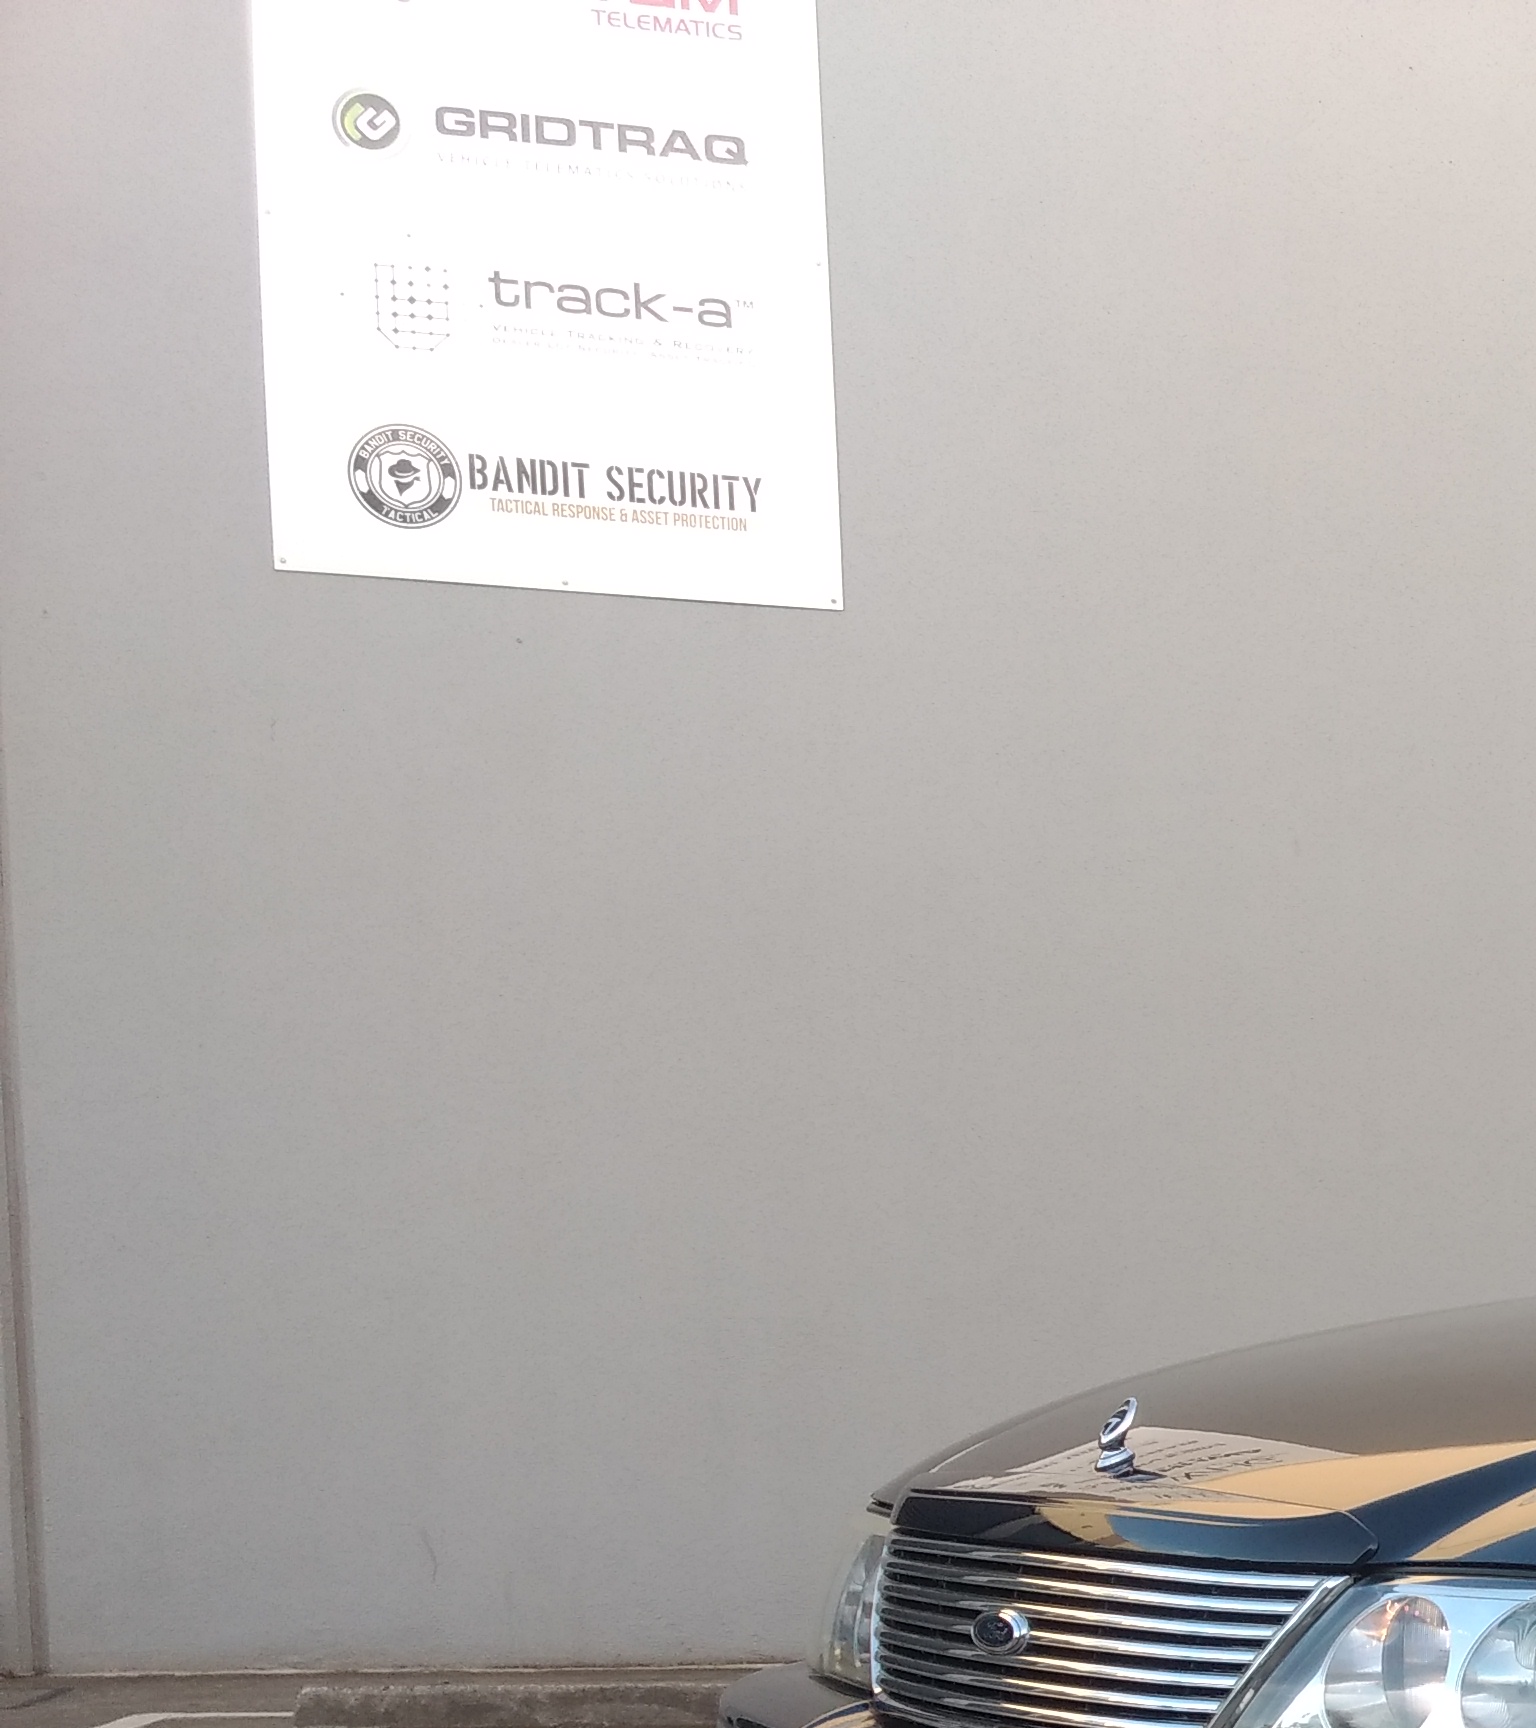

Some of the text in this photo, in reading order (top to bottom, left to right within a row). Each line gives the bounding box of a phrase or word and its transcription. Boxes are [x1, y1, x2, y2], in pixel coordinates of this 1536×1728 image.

[591, 9, 742, 40] TELEMATICS
[435, 106, 748, 166] GRIDTRAQ
[488, 271, 733, 328] track-a
[359, 431, 451, 465] BANDIT SECURITY
[468, 453, 762, 513] BANDIT SECURITY
[381, 505, 438, 523] TACTICAL
[489, 497, 748, 532] TACTICAL RESPONSE & ASSET PROTECTION
